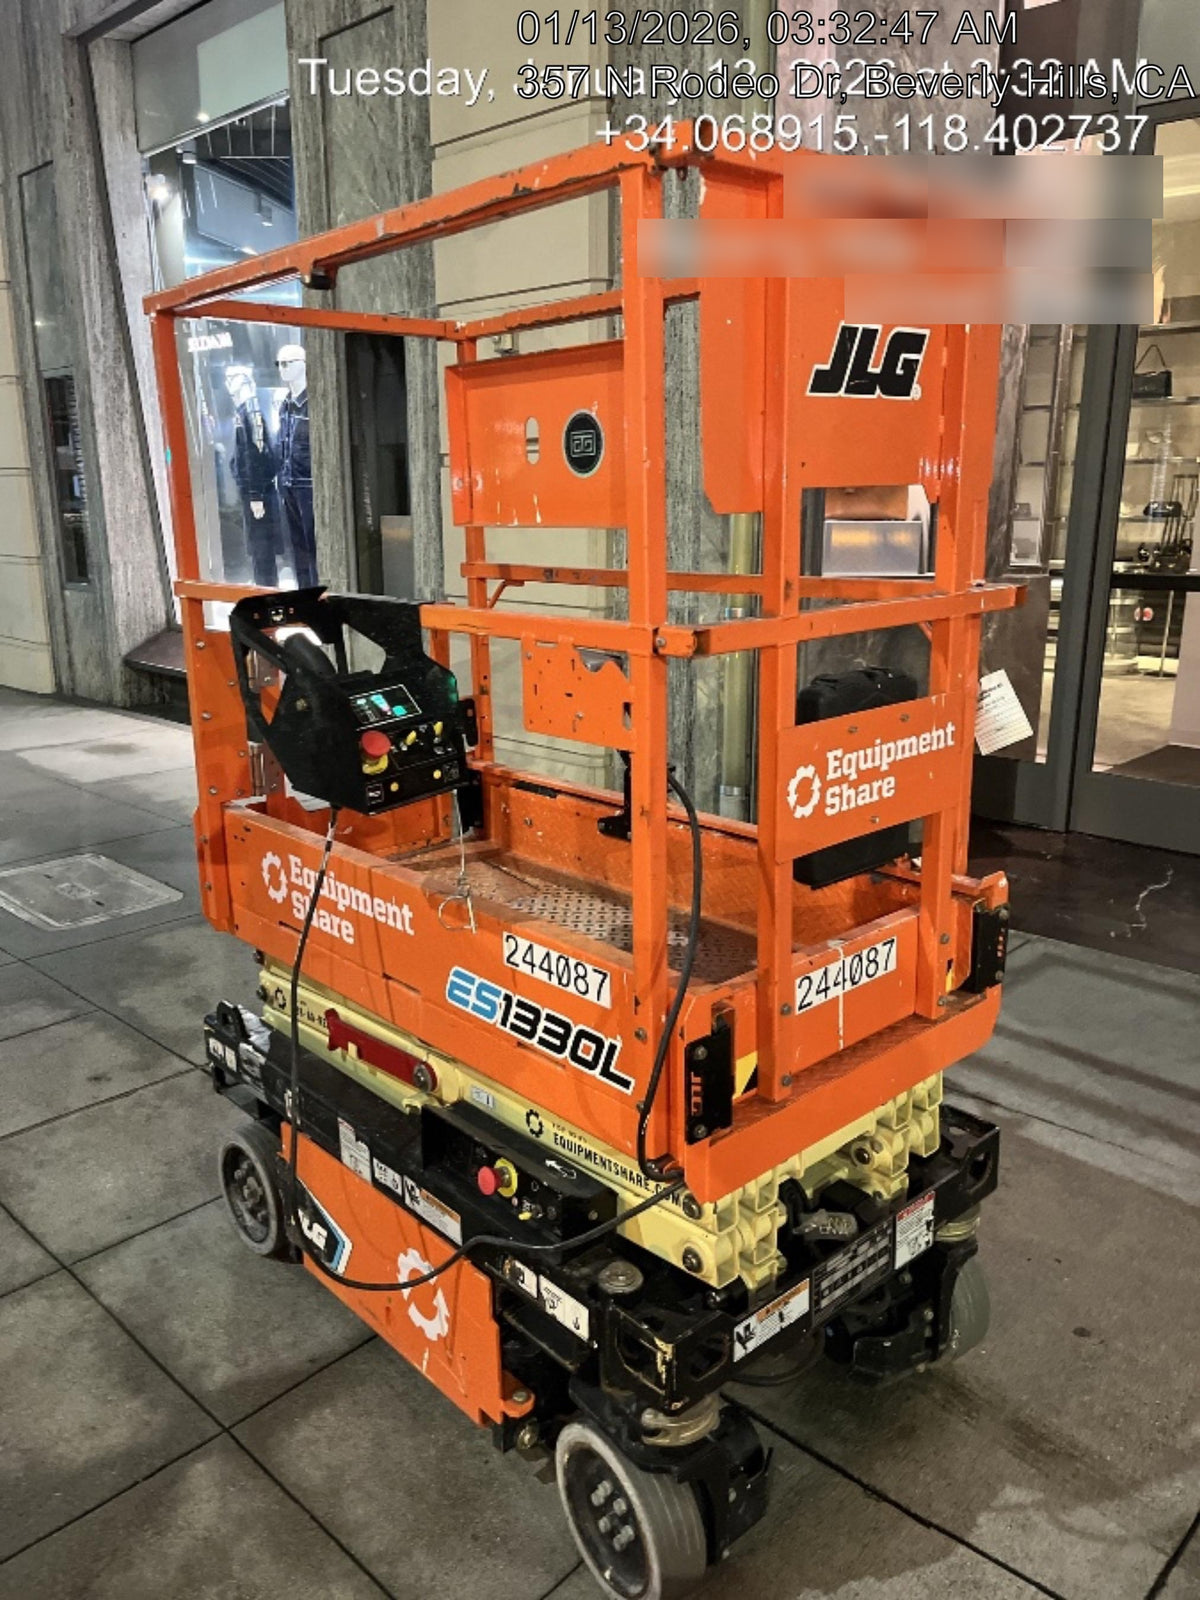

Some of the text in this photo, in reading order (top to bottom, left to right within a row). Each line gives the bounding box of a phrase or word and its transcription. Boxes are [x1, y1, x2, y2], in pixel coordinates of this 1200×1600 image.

[806, 322, 929, 399] JLG
[825, 720, 956, 782] Equipment
[824, 775, 896, 817] Share
[287, 854, 415, 937] Equipment
[505, 934, 609, 1002] 244087
[797, 937, 896, 1012] 244087
[447, 967, 633, 1092] ES1330L
[552, 1131, 682, 1208] EQUIPMENTSHARE.CM
